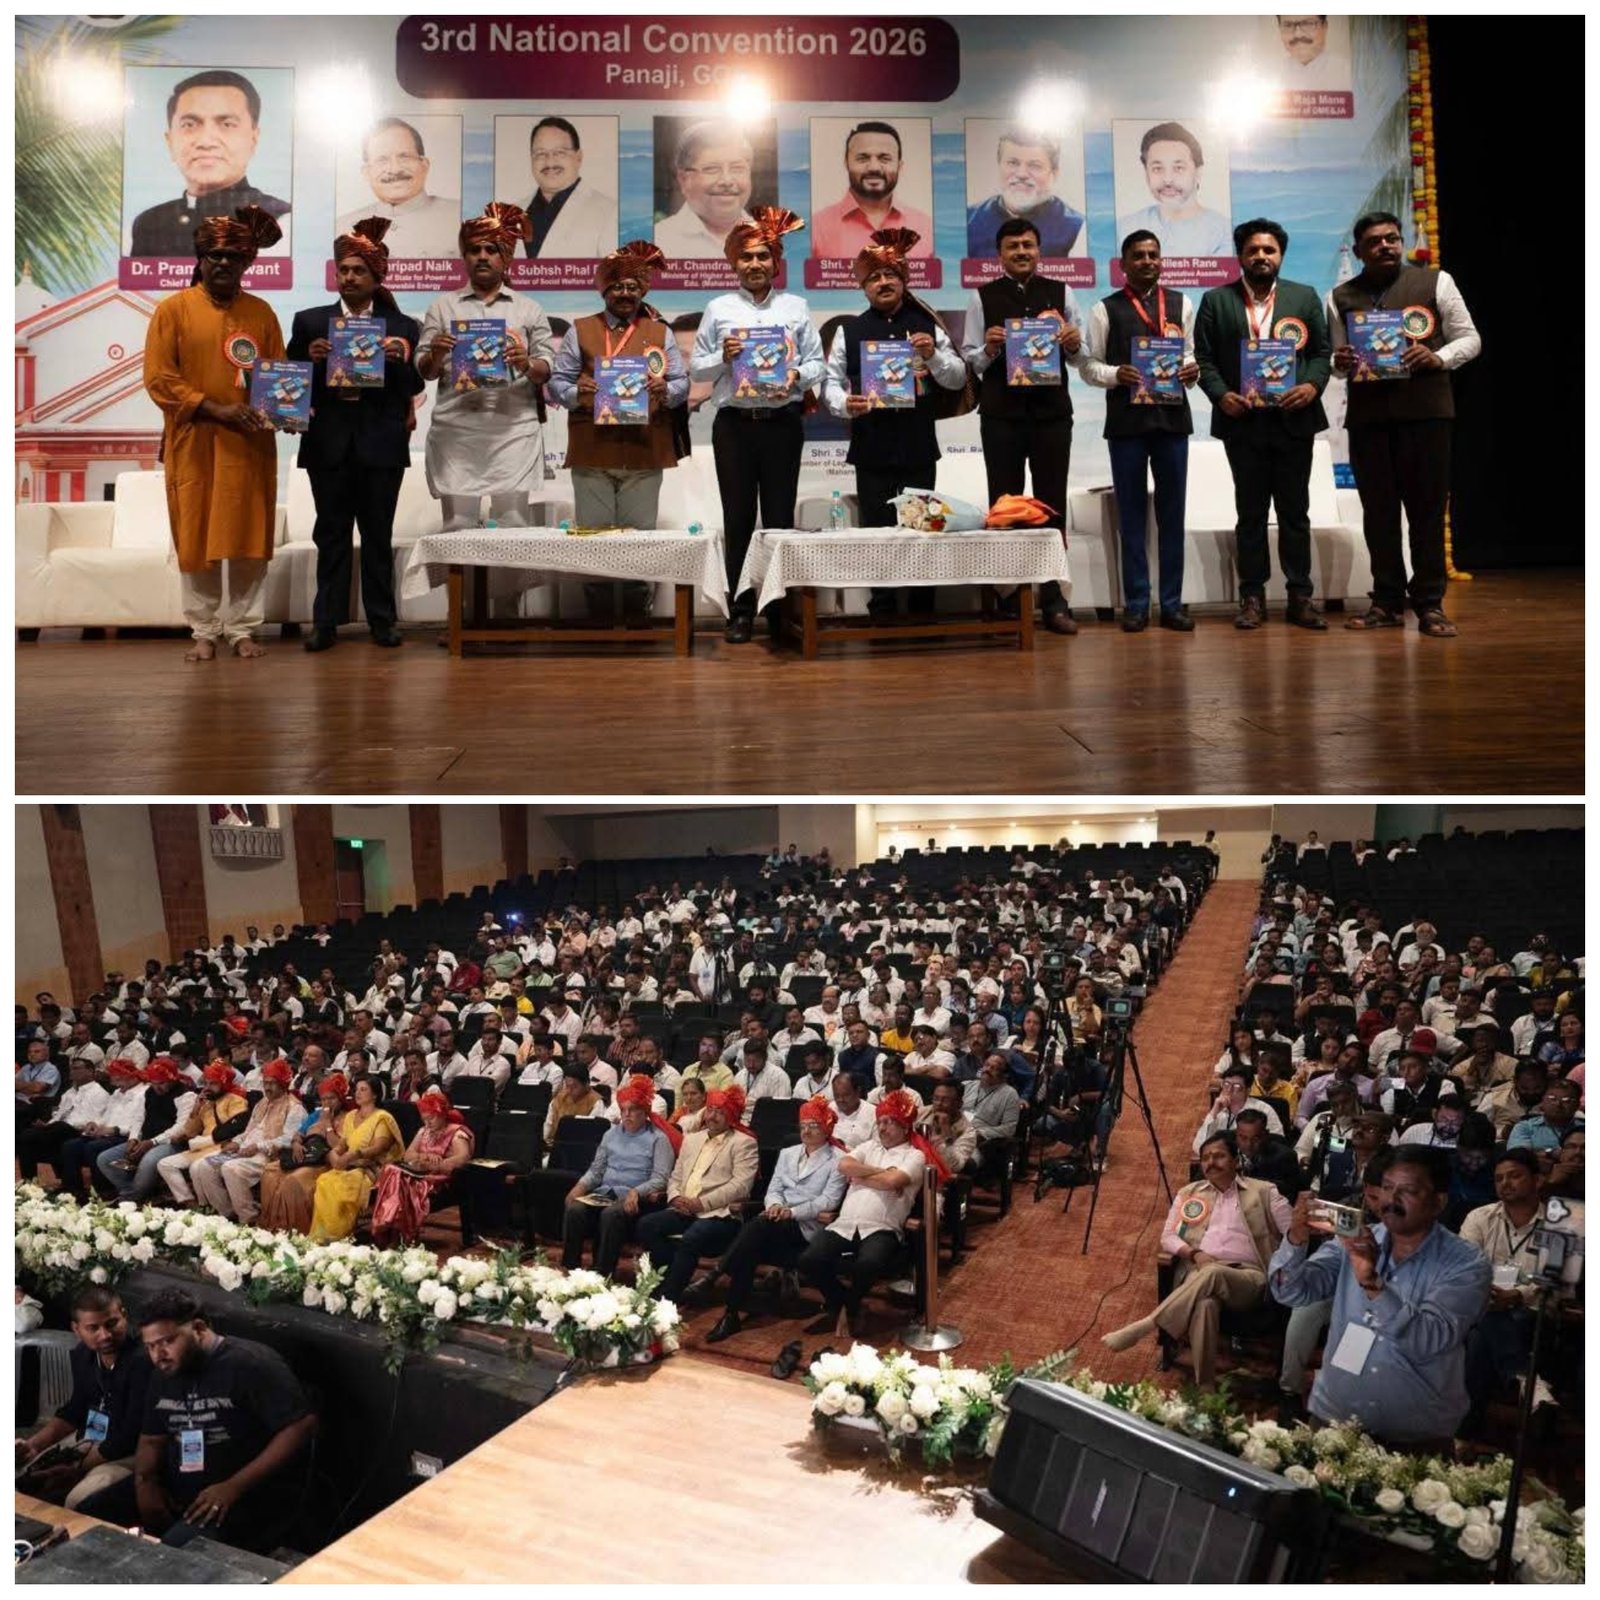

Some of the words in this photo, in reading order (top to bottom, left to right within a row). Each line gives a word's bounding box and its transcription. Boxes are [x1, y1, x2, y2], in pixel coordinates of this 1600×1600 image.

[420, 23, 476, 52] 3rd
[490, 23, 631, 53] National
[643, 25, 838, 55] Convention
[849, 27, 927, 56] 2026
[606, 64, 685, 88] Panaji,
[692, 65, 736, 87] GO
[131, 262, 153, 276] Dr.
[158, 262, 195, 276] Pram
[244, 262, 280, 276] want
[426, 260, 453, 272] Naik
[684, 261, 732, 271] Chandra
[820, 259, 845, 270] Shri.
[908, 261, 926, 270] ore
[1036, 262, 1075, 273] Samant
[1192, 258, 1218, 269] Rane
[565, 265, 590, 276] Phal
[160, 279, 184, 288] Chief
